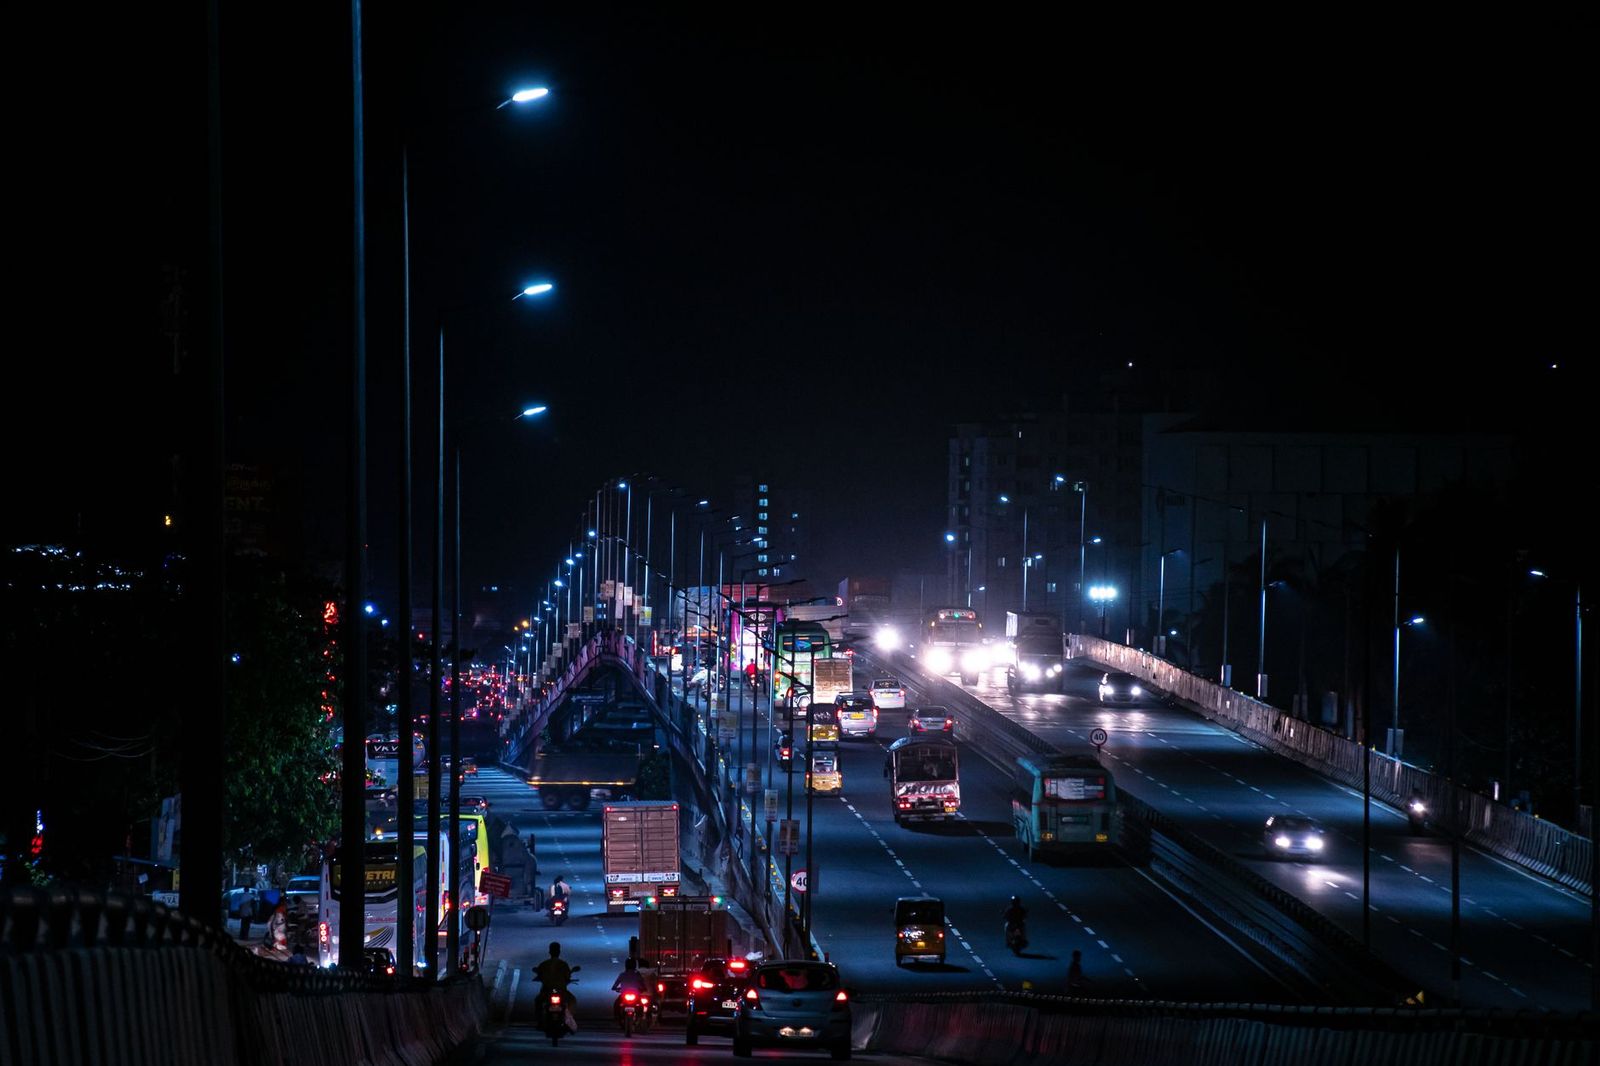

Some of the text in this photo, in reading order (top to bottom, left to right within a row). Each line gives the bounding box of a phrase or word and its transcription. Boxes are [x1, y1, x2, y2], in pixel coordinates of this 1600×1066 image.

[1094, 733, 1104, 741] 40
[364, 870, 396, 881] ETRI
[796, 877, 809, 887] 40
